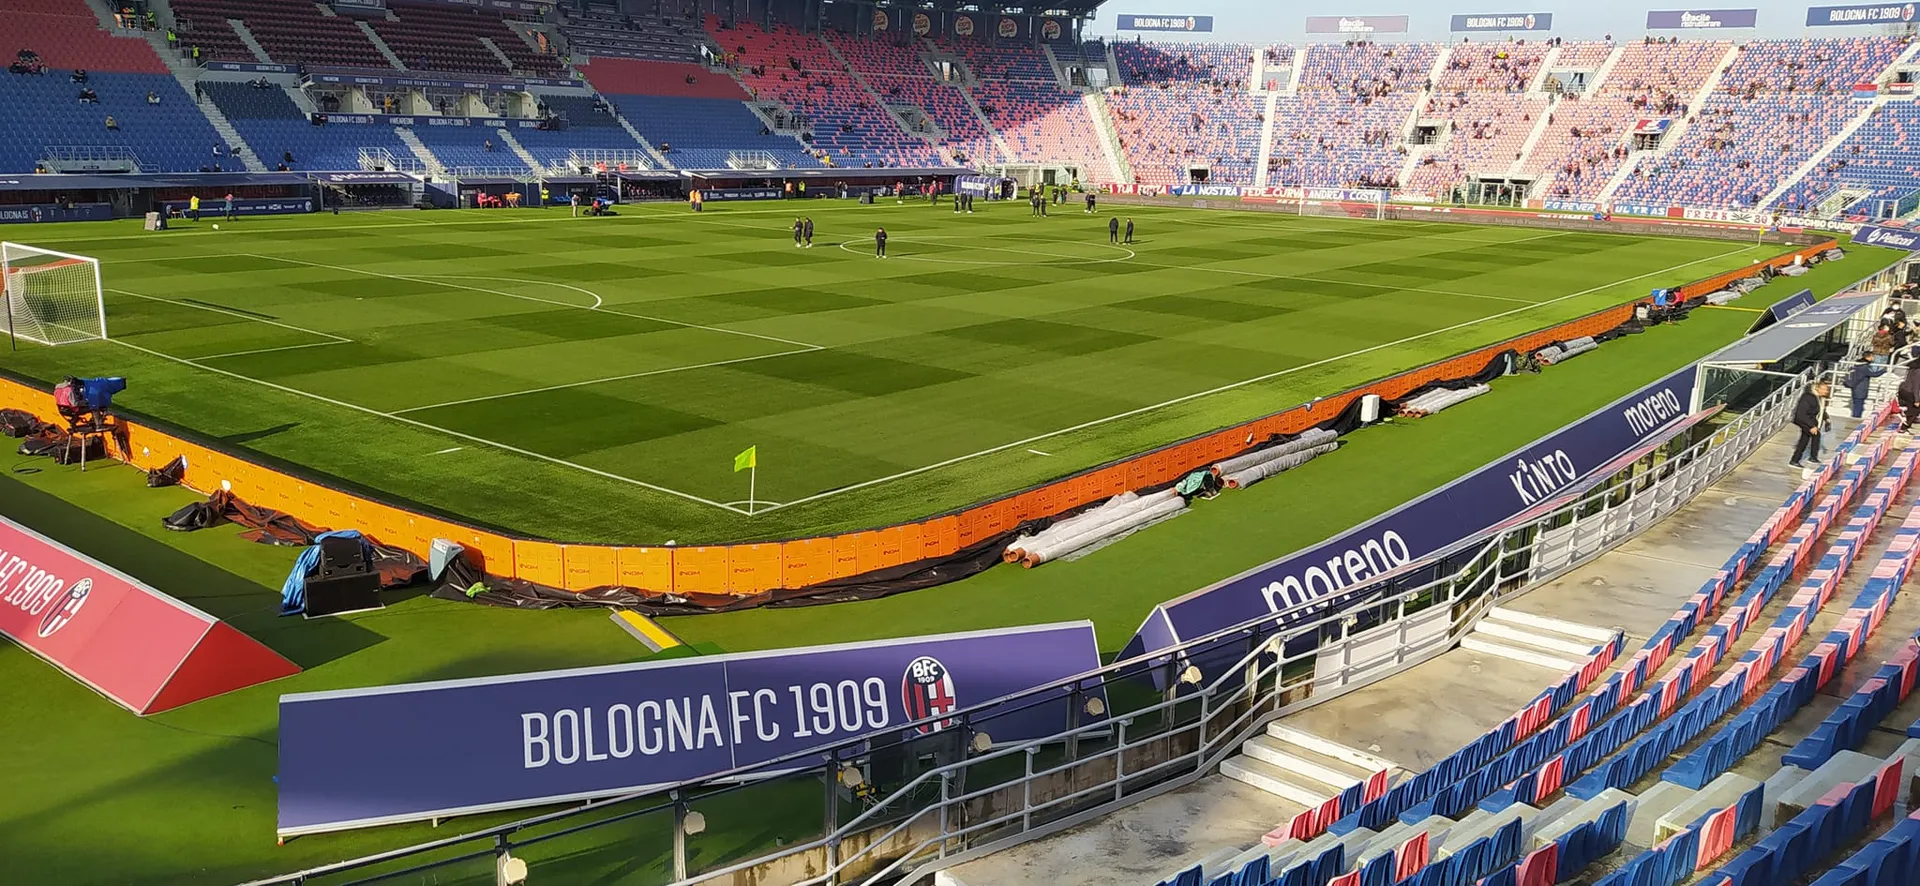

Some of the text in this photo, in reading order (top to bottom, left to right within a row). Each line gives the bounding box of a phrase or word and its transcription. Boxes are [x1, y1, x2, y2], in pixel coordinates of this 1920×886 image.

[1466, 17, 1524, 27] BOLOGNA FC 1909
[1830, 7, 1901, 21] BOLOGNA FC 1909
[1134, 18, 1186, 28] BOLOGNA FC 1909
[1199, 186, 1238, 196] NOSTRA
[1240, 187, 1268, 197] FEDE
[1273, 187, 1305, 198] CURVA
[1308, 190, 1345, 200] ANDREA
[1349, 191, 1381, 202] COSTA
[1614, 205, 1666, 215] ULTRAS
[1623, 387, 1681, 437] moreno
[1260, 530, 1411, 631] moreno
[4, 565, 65, 616] 1909
[912, 660, 938, 678] BFC
[917, 675, 935, 684] 1909
[520, 676, 890, 769] BOLOGNA FC 1909
